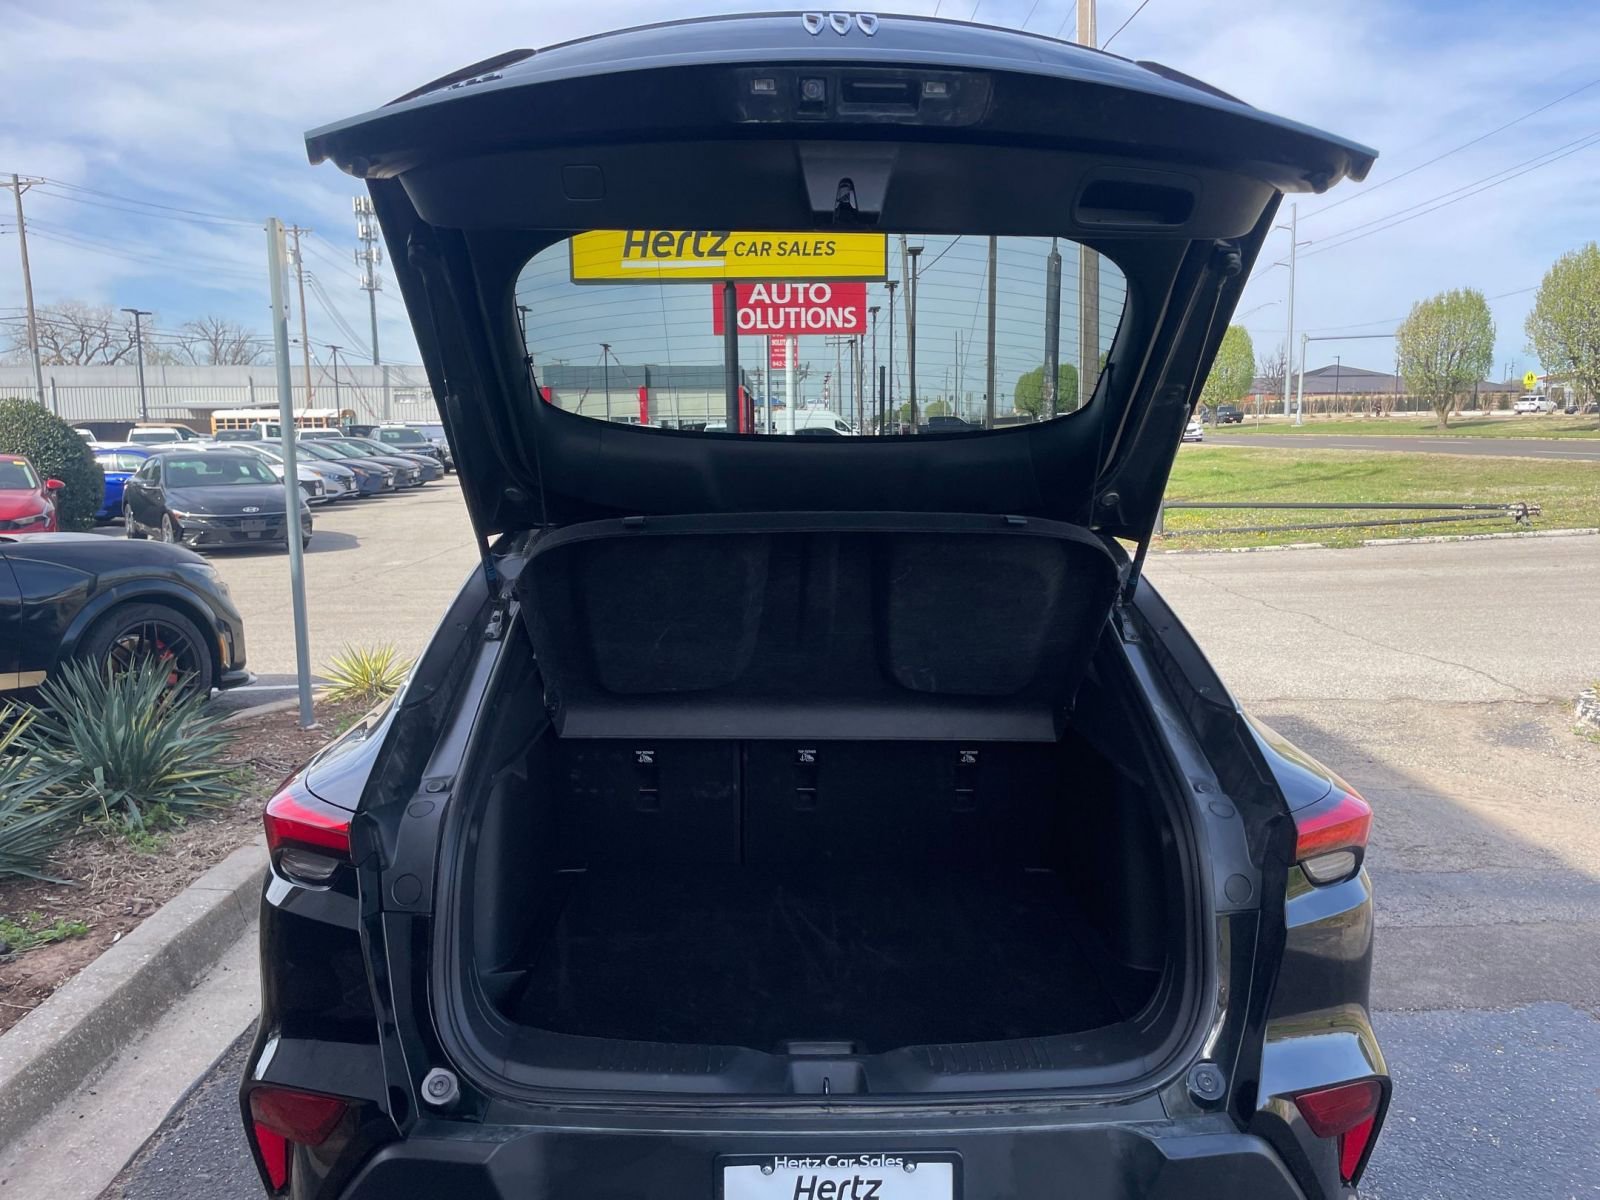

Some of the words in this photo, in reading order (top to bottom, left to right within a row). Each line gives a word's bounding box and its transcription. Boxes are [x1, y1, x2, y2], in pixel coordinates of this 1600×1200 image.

[623, 230, 731, 258] Hertz
[734, 241, 772, 257] CAR
[776, 241, 837, 257] SALES
[748, 282, 832, 304] AUTO
[736, 307, 857, 329] OLUTIONS
[774, 1156, 821, 1169] Hertz
[825, 1155, 856, 1168] Car
[859, 1153, 904, 1168] Sales
[793, 1175, 883, 1200] Hertz
